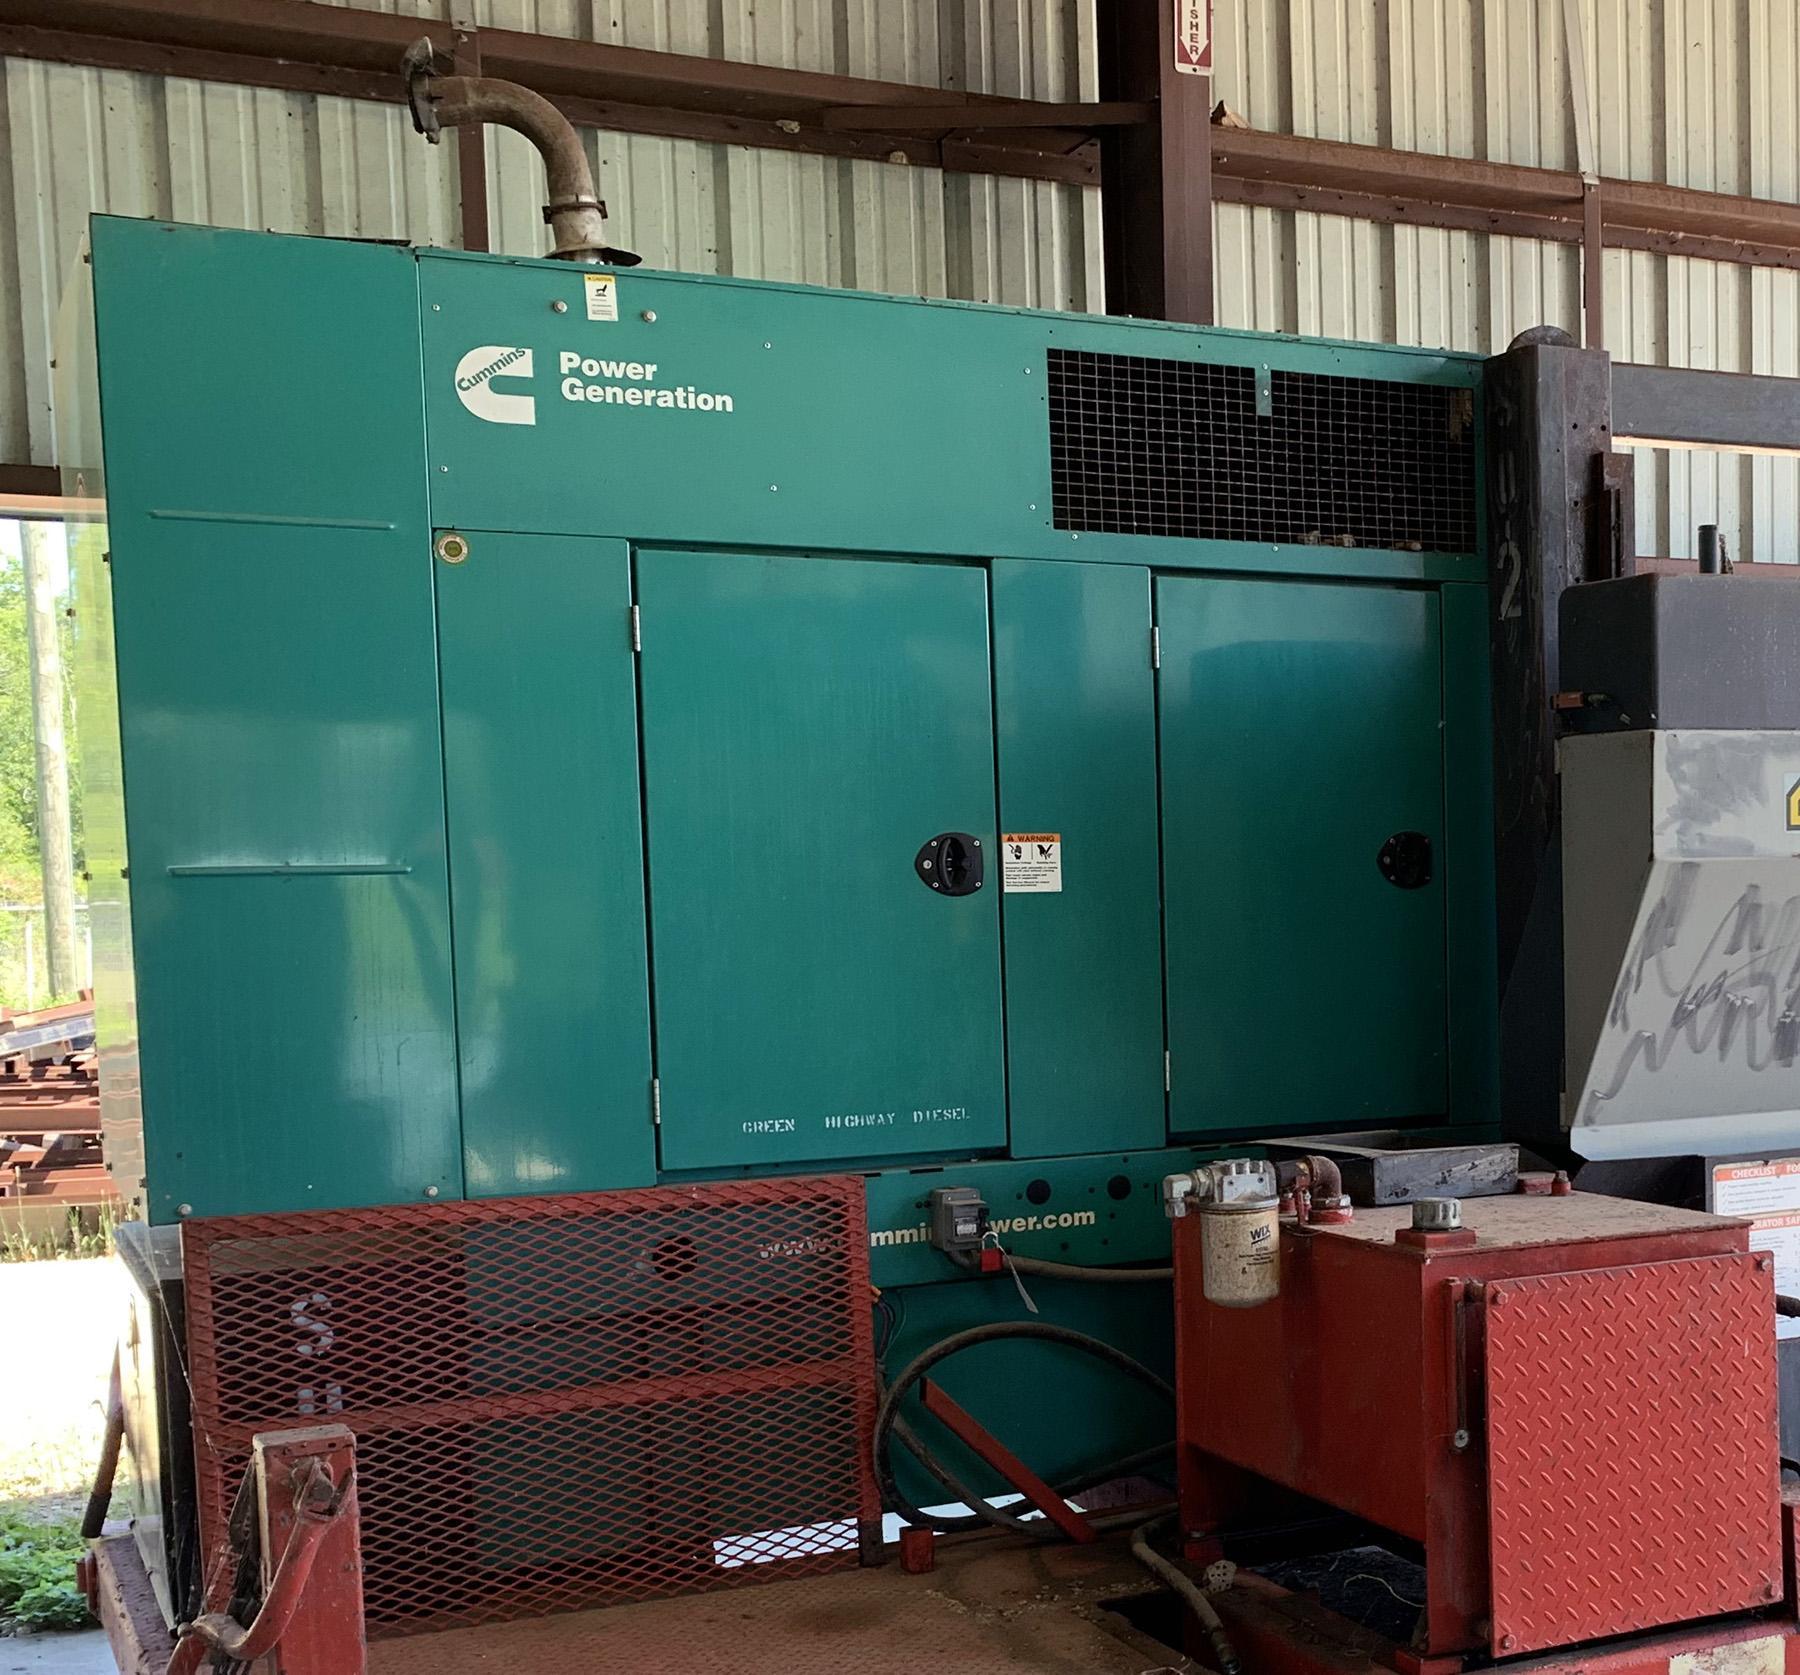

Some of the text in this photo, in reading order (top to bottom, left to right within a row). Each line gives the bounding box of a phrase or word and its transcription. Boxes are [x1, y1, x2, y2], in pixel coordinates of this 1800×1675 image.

[456, 346, 527, 392] Cummins
[559, 351, 658, 381] Power
[561, 377, 734, 413] Generation
[1017, 835, 1055, 843] WARNING
[742, 1107, 971, 1134] GREEN HIGHWAY DIESEL
[1731, 1165, 1776, 1179] CHECKLIST
[1250, 1223, 1271, 1241] WIX
